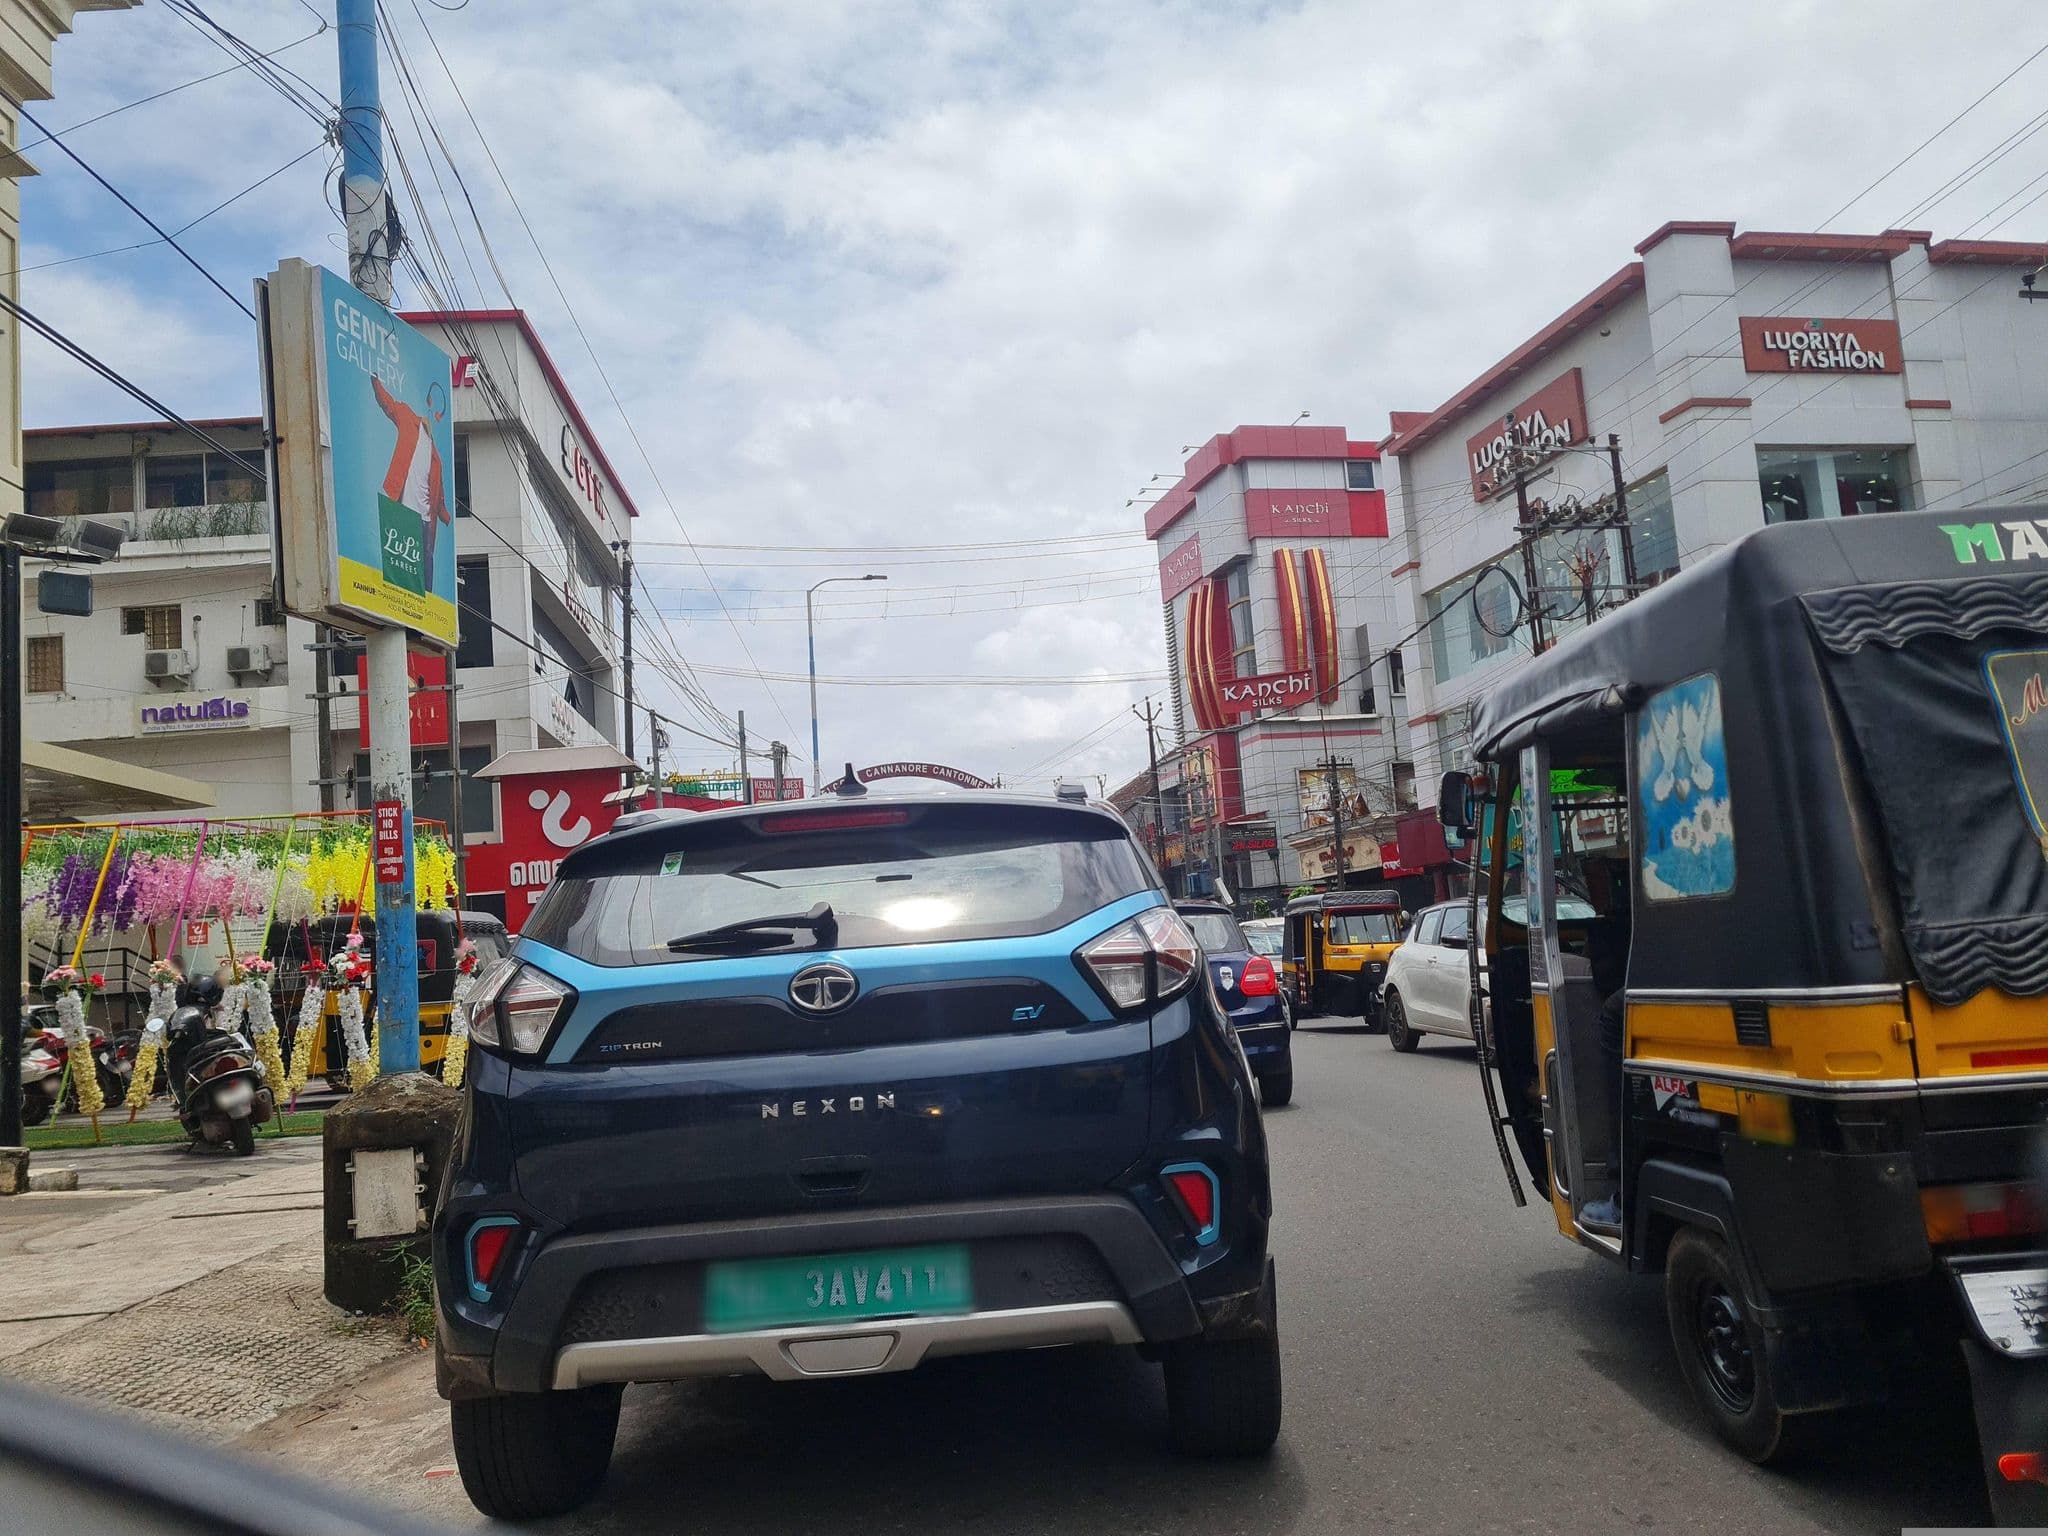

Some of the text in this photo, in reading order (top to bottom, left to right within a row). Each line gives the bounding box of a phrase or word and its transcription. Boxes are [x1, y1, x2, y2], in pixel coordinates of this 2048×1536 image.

[334, 298, 400, 363] GENTS
[1764, 331, 1861, 351] LUORIYA
[336, 332, 406, 394] GALLERY
[1788, 350, 1885, 369] FASHION
[390, 557, 418, 575] SAREES
[1252, 696, 1283, 707] SILKS
[865, 764, 928, 778] CANNANORE
[786, 780, 803, 789] BEST
[758, 790, 772, 799] CMA
[378, 807, 398, 818] STICK
[382, 818, 394, 829] NO
[379, 830, 399, 840] BILLS
[1012, 1004, 1046, 1022] EV
[600, 1041, 663, 1053] ZIPTRON
[1654, 1075, 1690, 1098] ALFA
[761, 1093, 895, 1119] NEXON
